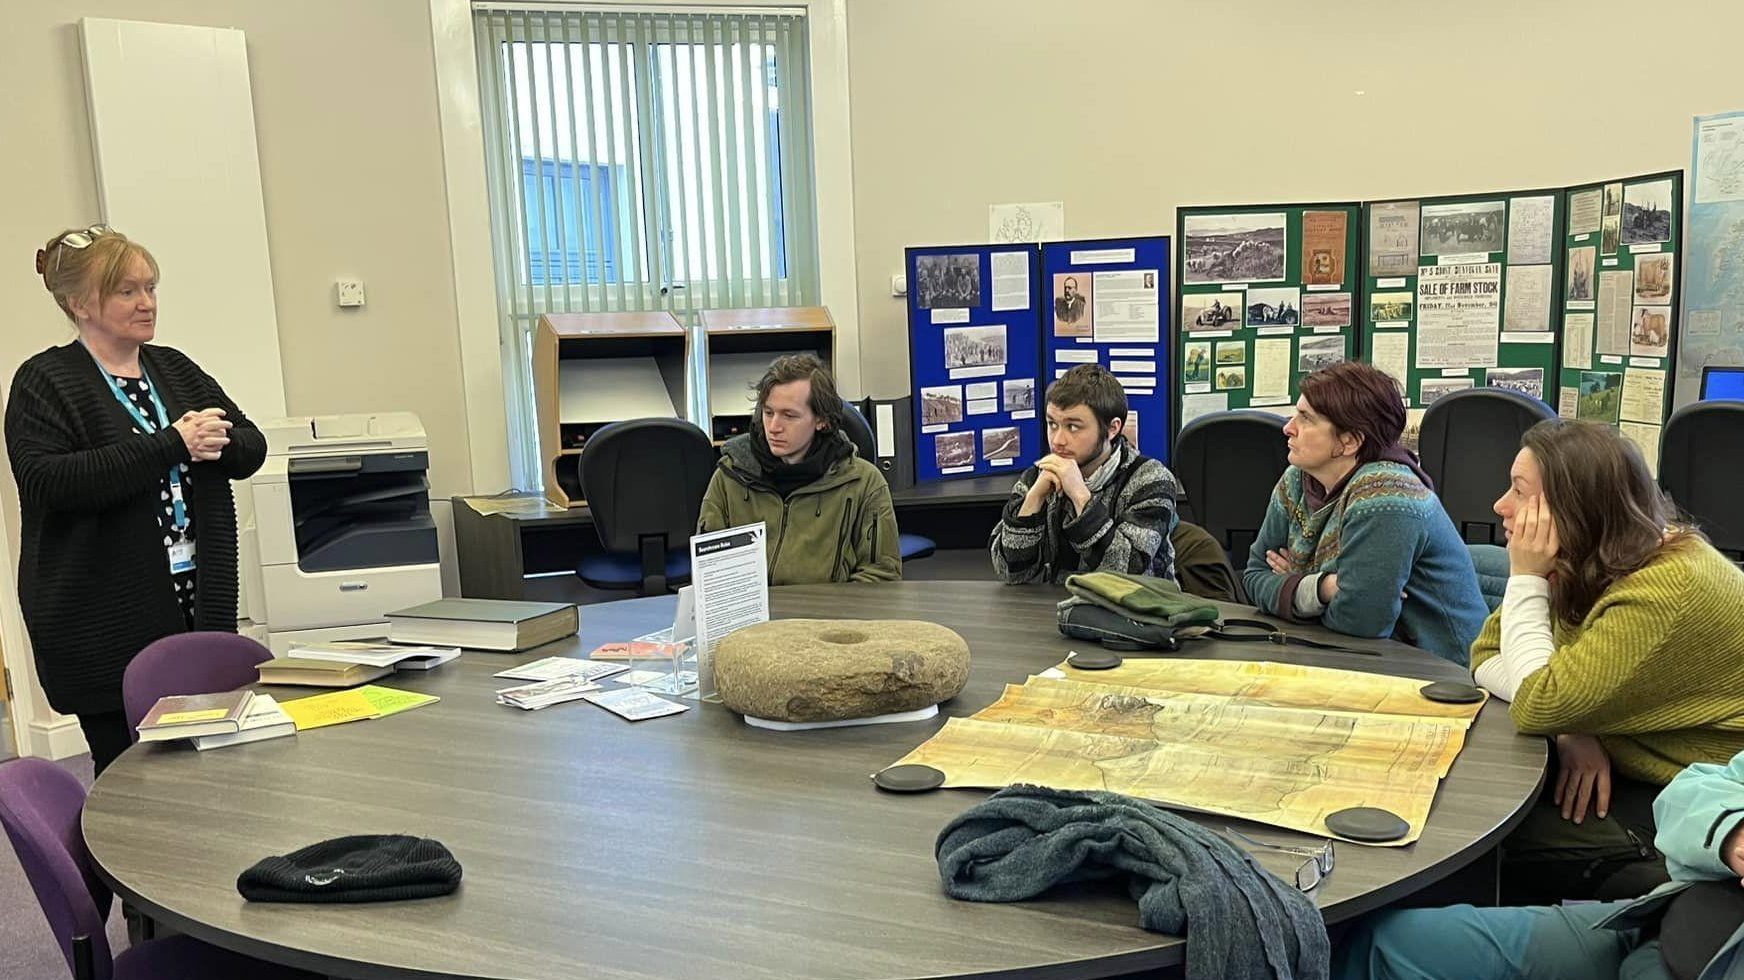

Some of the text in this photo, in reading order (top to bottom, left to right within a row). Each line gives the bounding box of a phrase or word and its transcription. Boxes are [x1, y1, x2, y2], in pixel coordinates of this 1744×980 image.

[1420, 281, 1498, 296] SALE OF FARM STOCK
